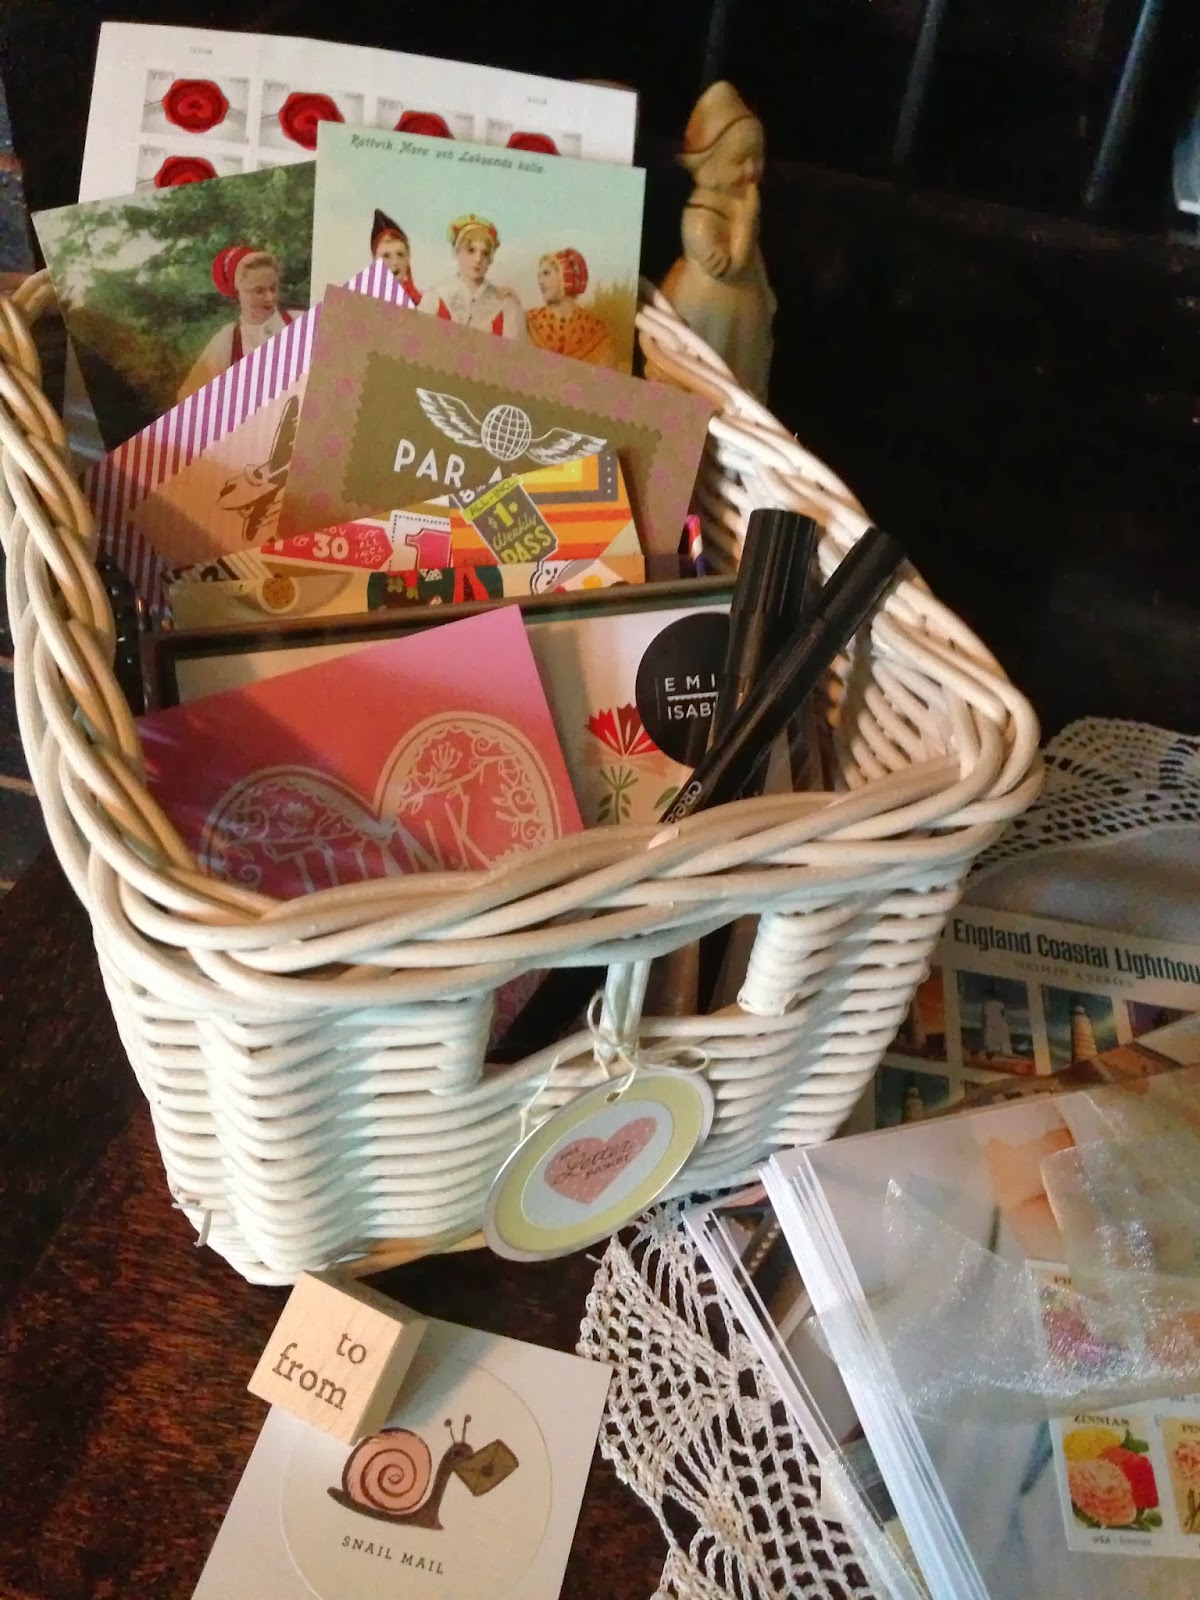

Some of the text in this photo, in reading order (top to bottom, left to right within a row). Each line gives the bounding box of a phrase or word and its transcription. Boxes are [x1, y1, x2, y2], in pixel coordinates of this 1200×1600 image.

[393, 438, 466, 488] PAR
[311, 532, 350, 560] 30
[501, 525, 552, 564] PASS
[667, 700, 717, 720] ISAB
[952, 918, 1032, 955] England
[1036, 934, 1110, 969] Coastal
[334, 1331, 368, 1366] to
[271, 1342, 349, 1412] from
[341, 1535, 445, 1576] SNAIL MAIL
